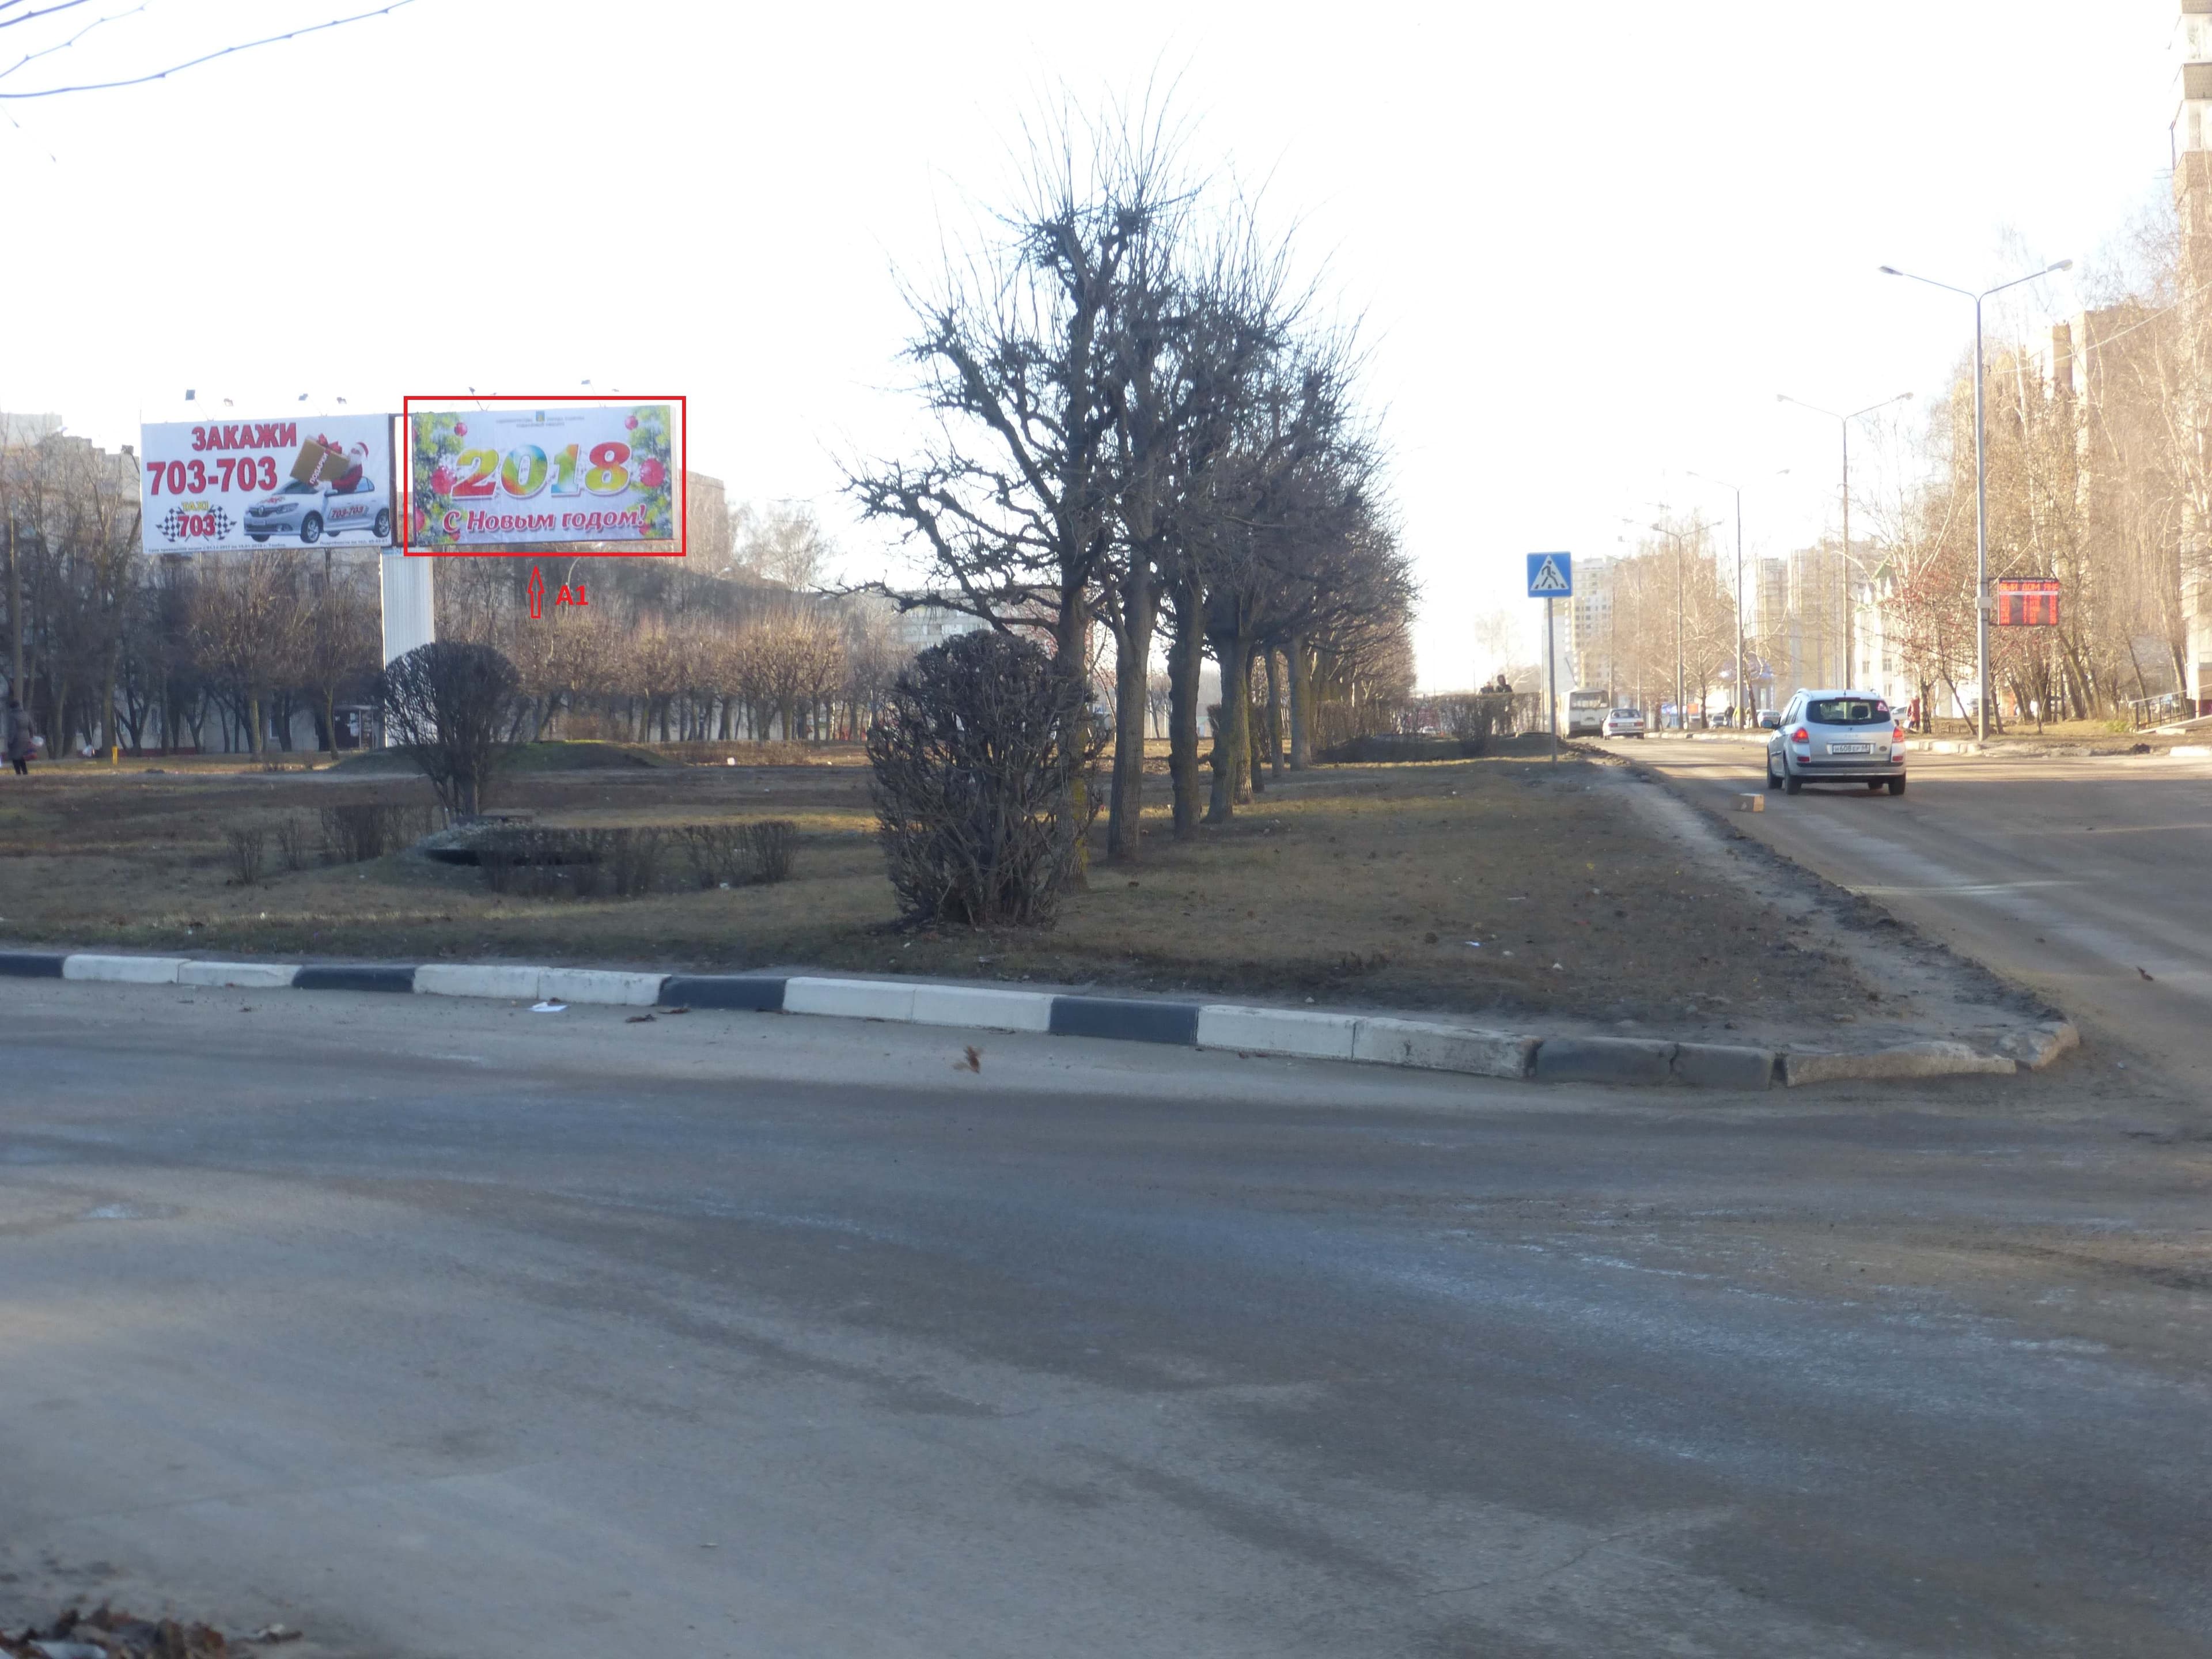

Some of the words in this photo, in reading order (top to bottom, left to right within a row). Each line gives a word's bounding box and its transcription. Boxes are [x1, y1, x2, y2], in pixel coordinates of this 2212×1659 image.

[192, 422, 297, 452] ЗАКАЖИ
[146, 456, 278, 495] 703-703
[450, 441, 632, 500] 2018
[177, 514, 215, 537] 703
[332, 505, 363, 518] 703-703
[443, 510, 460, 532] С
[467, 510, 555, 533] Новым
[562, 503, 646, 532] годом!
[2021, 583, 2040, 592] ДОМ
